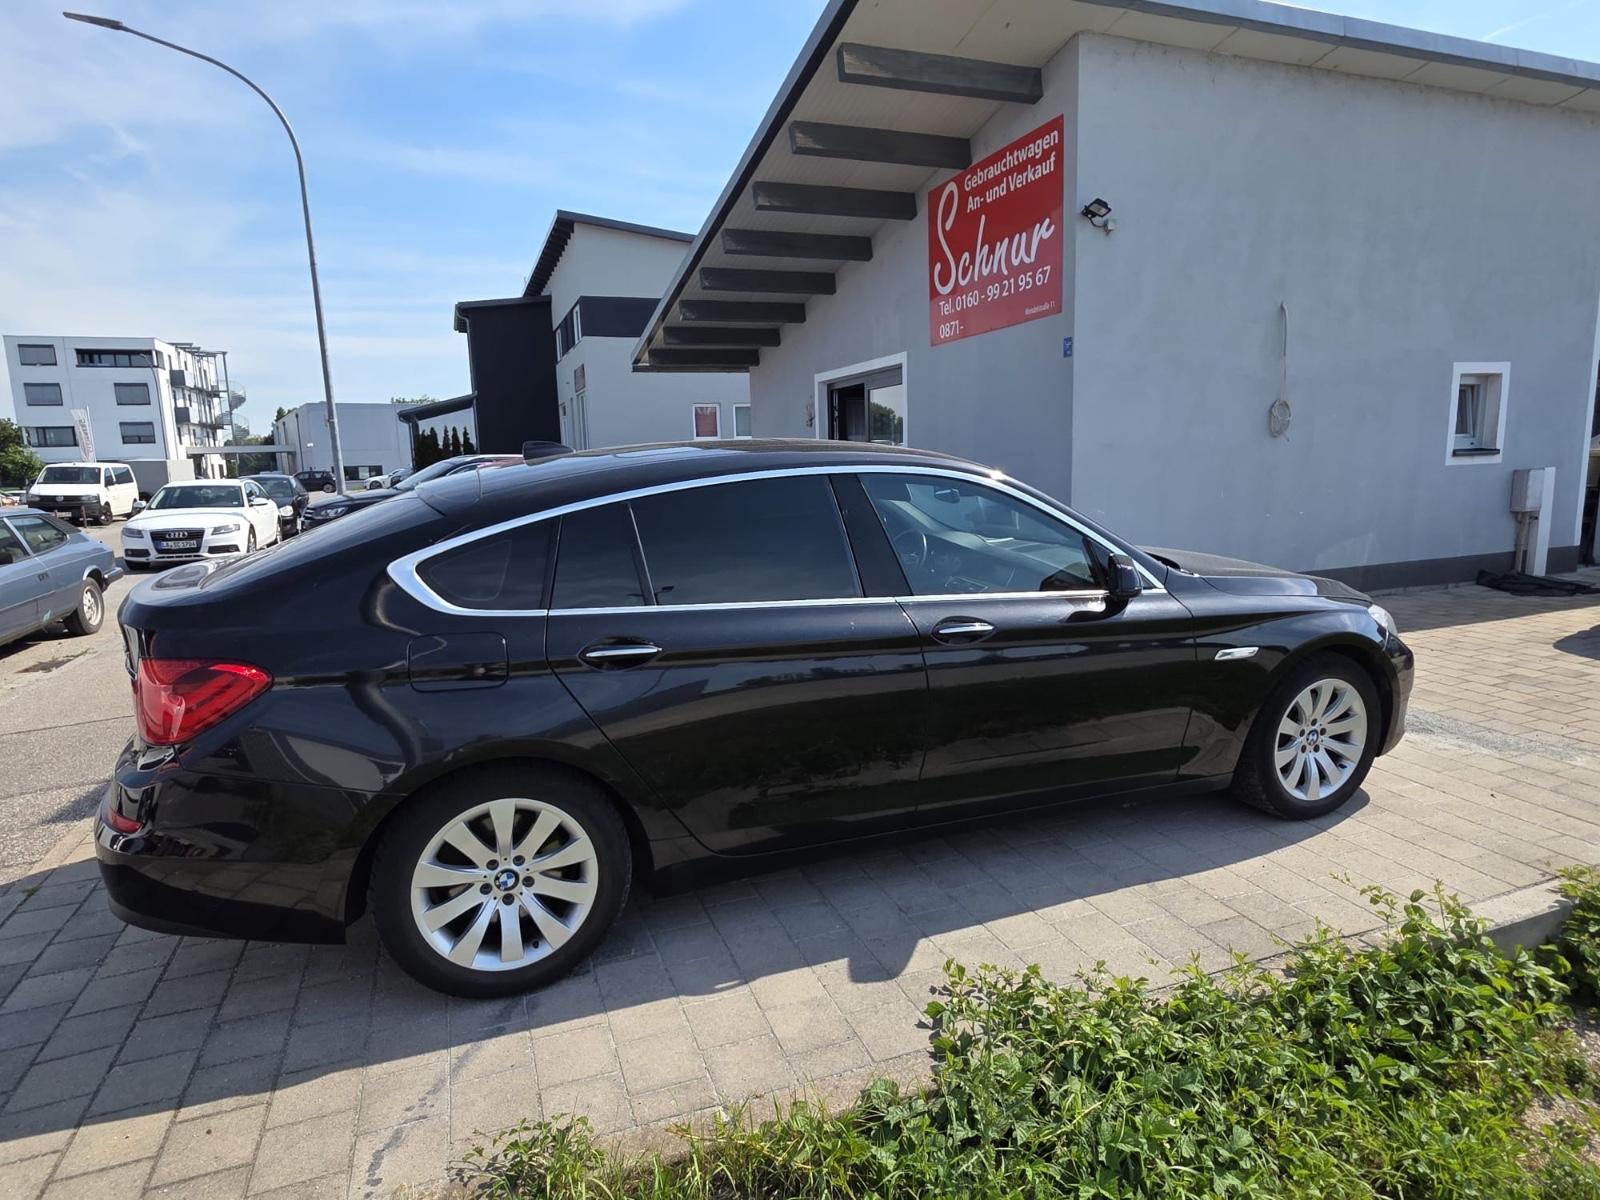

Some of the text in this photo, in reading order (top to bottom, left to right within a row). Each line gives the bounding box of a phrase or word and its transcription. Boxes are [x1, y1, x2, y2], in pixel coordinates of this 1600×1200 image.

[964, 130, 1059, 192] Gebrauchtwagen
[967, 151, 1056, 213] An- und Verkauf
[934, 181, 1055, 295] Schnur
[939, 298, 955, 316] Tel.
[955, 290, 979, 312] 0160
[987, 283, 1000, 302] 99
[1002, 278, 1014, 298] 21
[1018, 271, 1032, 292] 95
[1035, 265, 1051, 286] 67
[940, 320, 964, 339] 0871-
